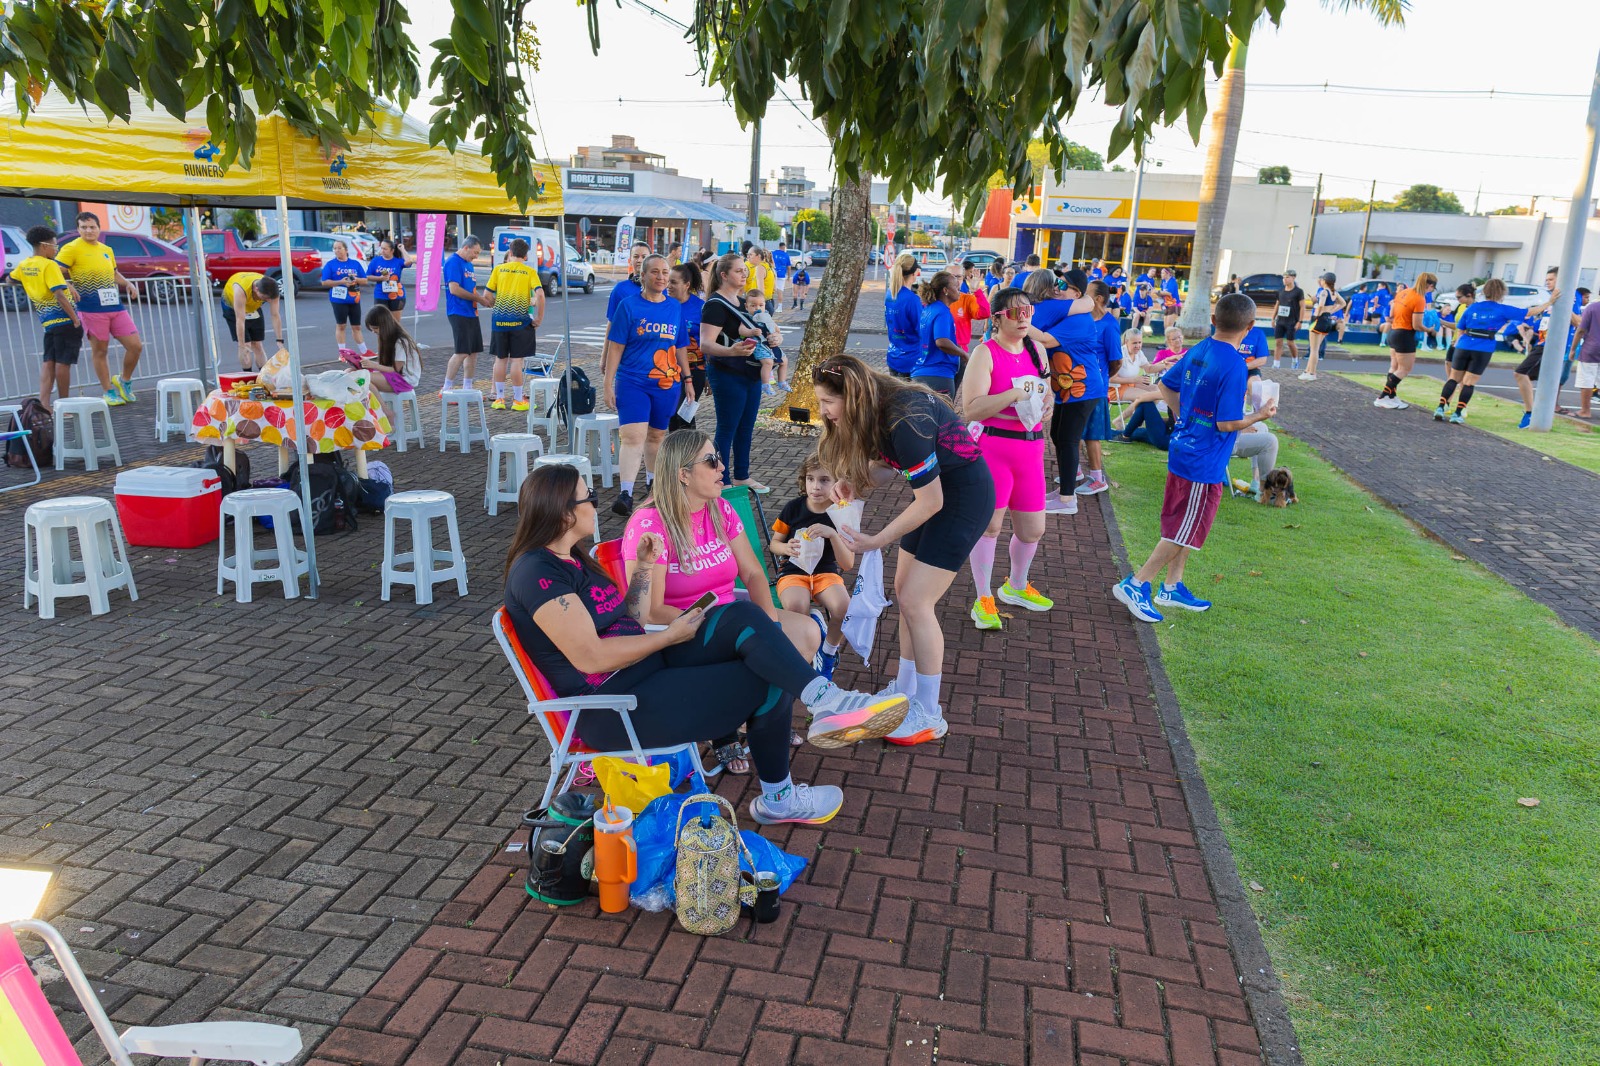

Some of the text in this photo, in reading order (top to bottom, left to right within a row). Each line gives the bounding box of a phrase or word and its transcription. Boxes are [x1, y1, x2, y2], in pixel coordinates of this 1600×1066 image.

[184, 164, 224, 178] RUNNERS
[571, 174, 630, 185] RORIZ BURGER
[1070, 205, 1102, 214] Correios
[425, 221, 437, 249] ROSA
[645, 322, 677, 335] CORES
[1240, 344, 1254, 353] RES
